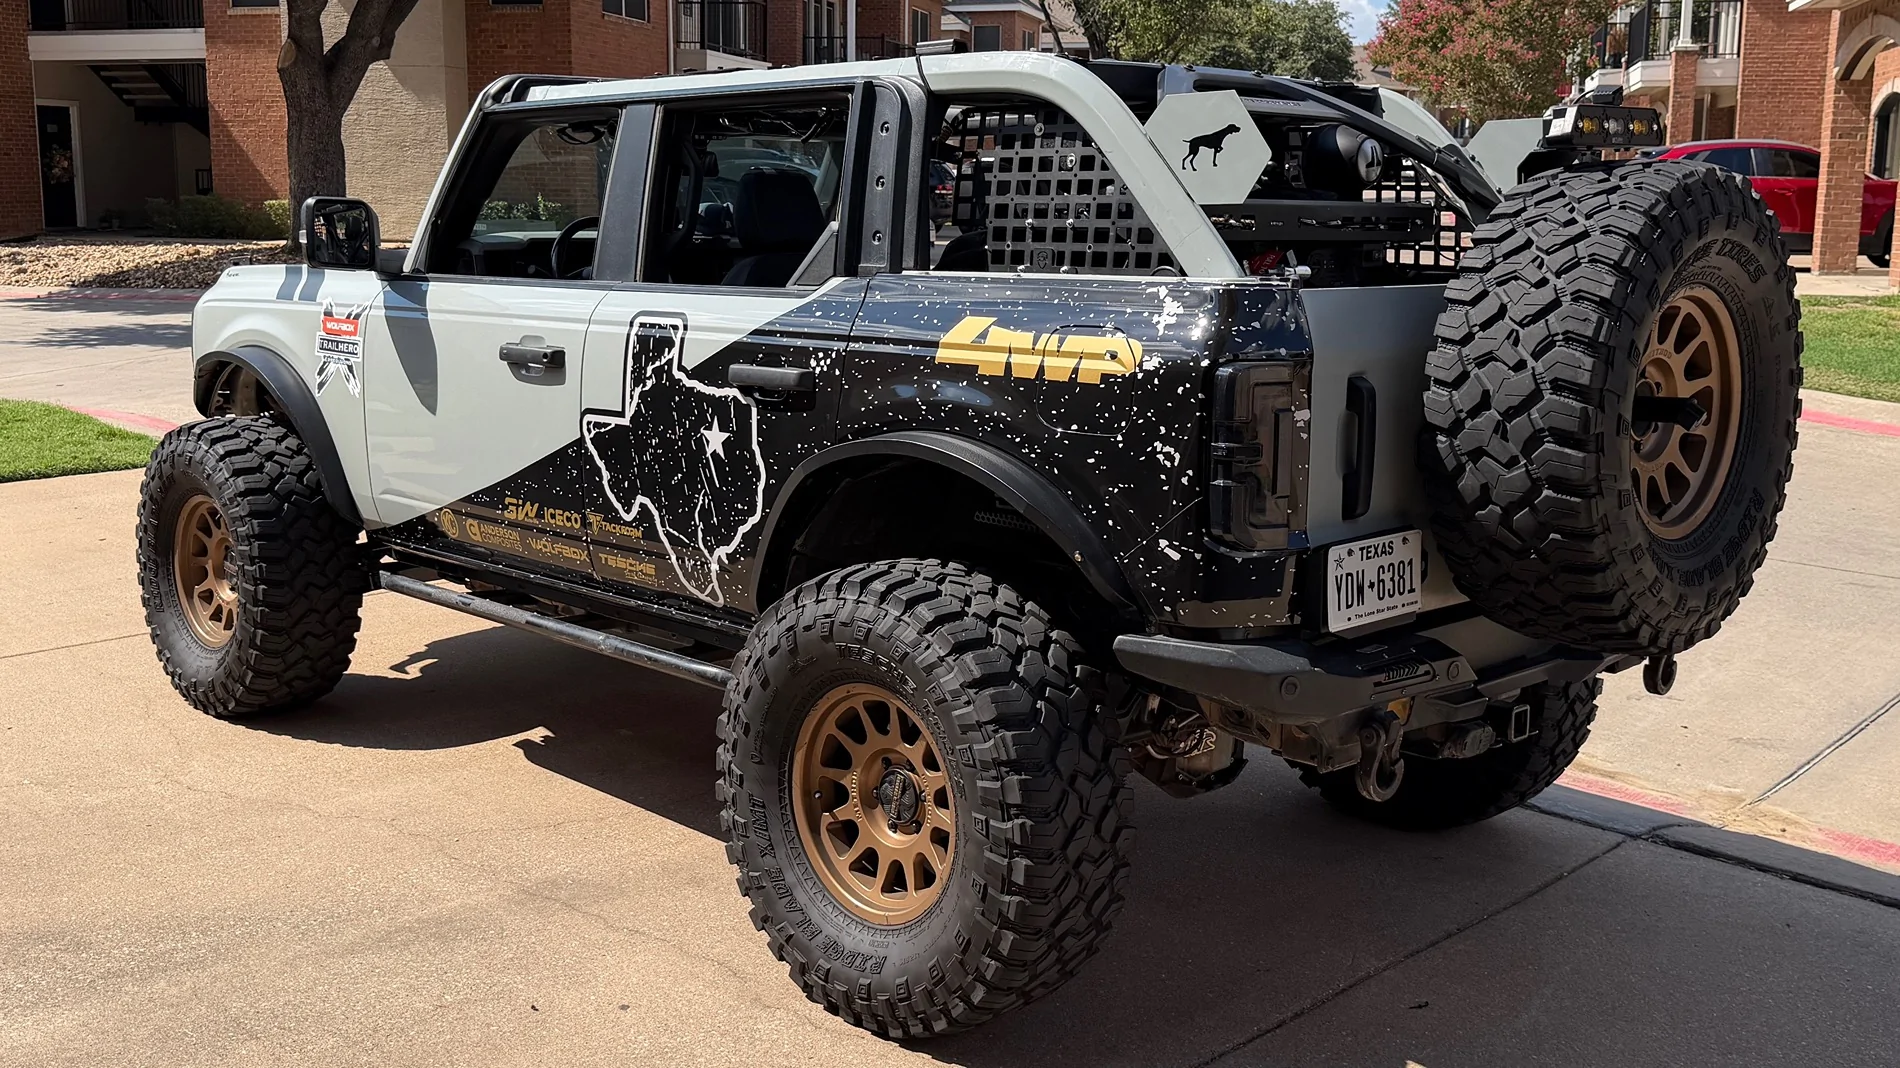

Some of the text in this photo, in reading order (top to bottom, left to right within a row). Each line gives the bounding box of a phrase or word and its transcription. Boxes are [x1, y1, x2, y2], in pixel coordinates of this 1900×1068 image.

[1716, 237, 1768, 283] TIRES
[326, 320, 355, 332] WOLFBOX
[319, 340, 359, 353] TRAILHERO
[935, 316, 1143, 385] 4WP
[480, 523, 520, 541] ANDERSON
[544, 507, 581, 529] ICECO
[601, 521, 642, 539] TACKFORM
[481, 533, 522, 551] COMPOSITES
[527, 537, 590, 562] WOLFBOX
[1359, 540, 1394, 561] TEXAS
[1335, 558, 1416, 612] YDW 6381
[764, 866, 823, 942] BLADE
[815, 934, 887, 975] RIDGE
